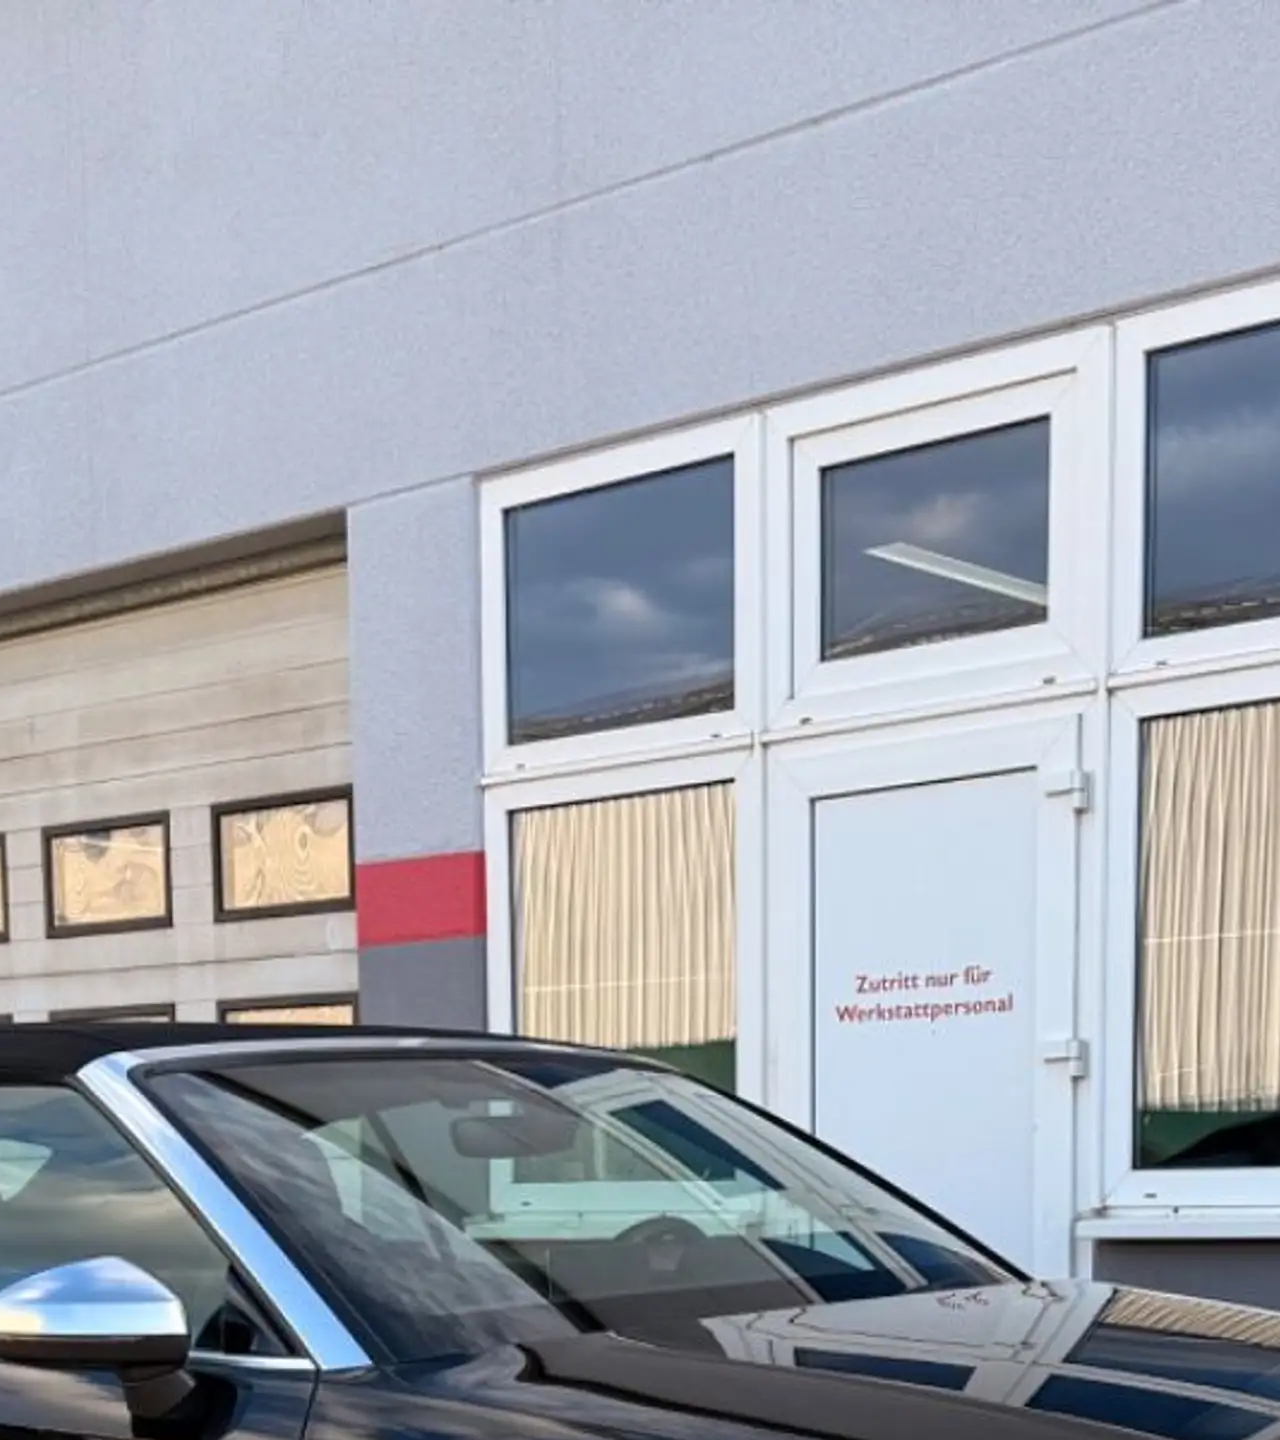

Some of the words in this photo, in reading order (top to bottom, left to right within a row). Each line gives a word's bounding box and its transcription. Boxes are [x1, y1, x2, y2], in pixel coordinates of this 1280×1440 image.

[855, 970, 920, 994] Zutritt
[924, 972, 959, 990] nur
[963, 964, 993, 985] für
[834, 993, 1014, 1024] Werkstattpersonal
